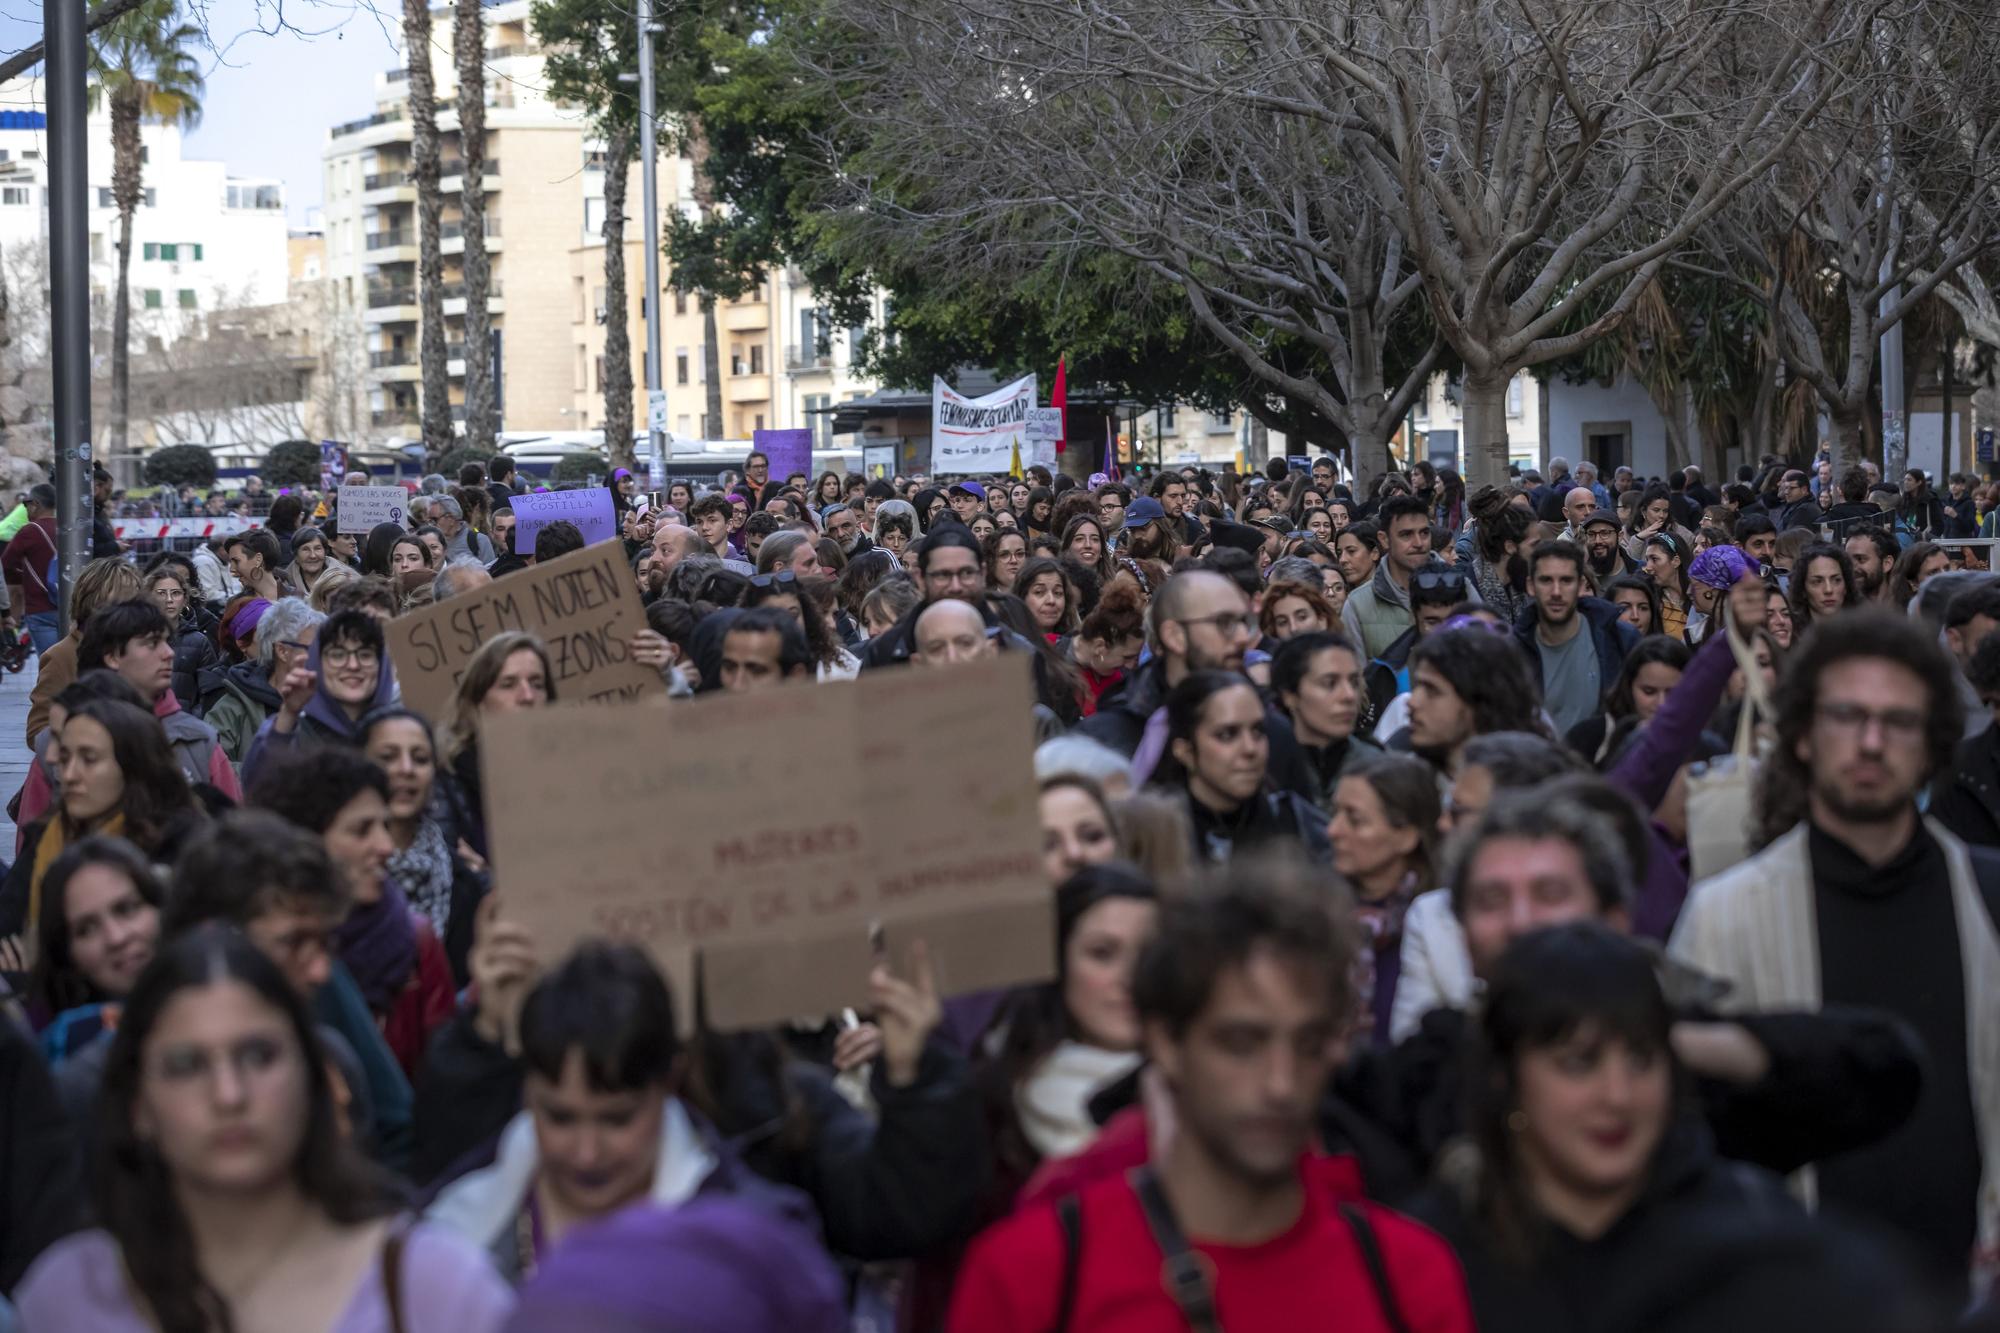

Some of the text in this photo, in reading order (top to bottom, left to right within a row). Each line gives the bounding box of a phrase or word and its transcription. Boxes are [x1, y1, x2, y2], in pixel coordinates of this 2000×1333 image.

[515, 496, 534, 504] NO
[583, 490, 597, 498] TU
[530, 500, 593, 511] COSTILLA
[520, 519, 531, 529] TU
[408, 617, 448, 673] SI
[530, 558, 622, 626] NOTEN
[811, 882, 860, 914] LA
